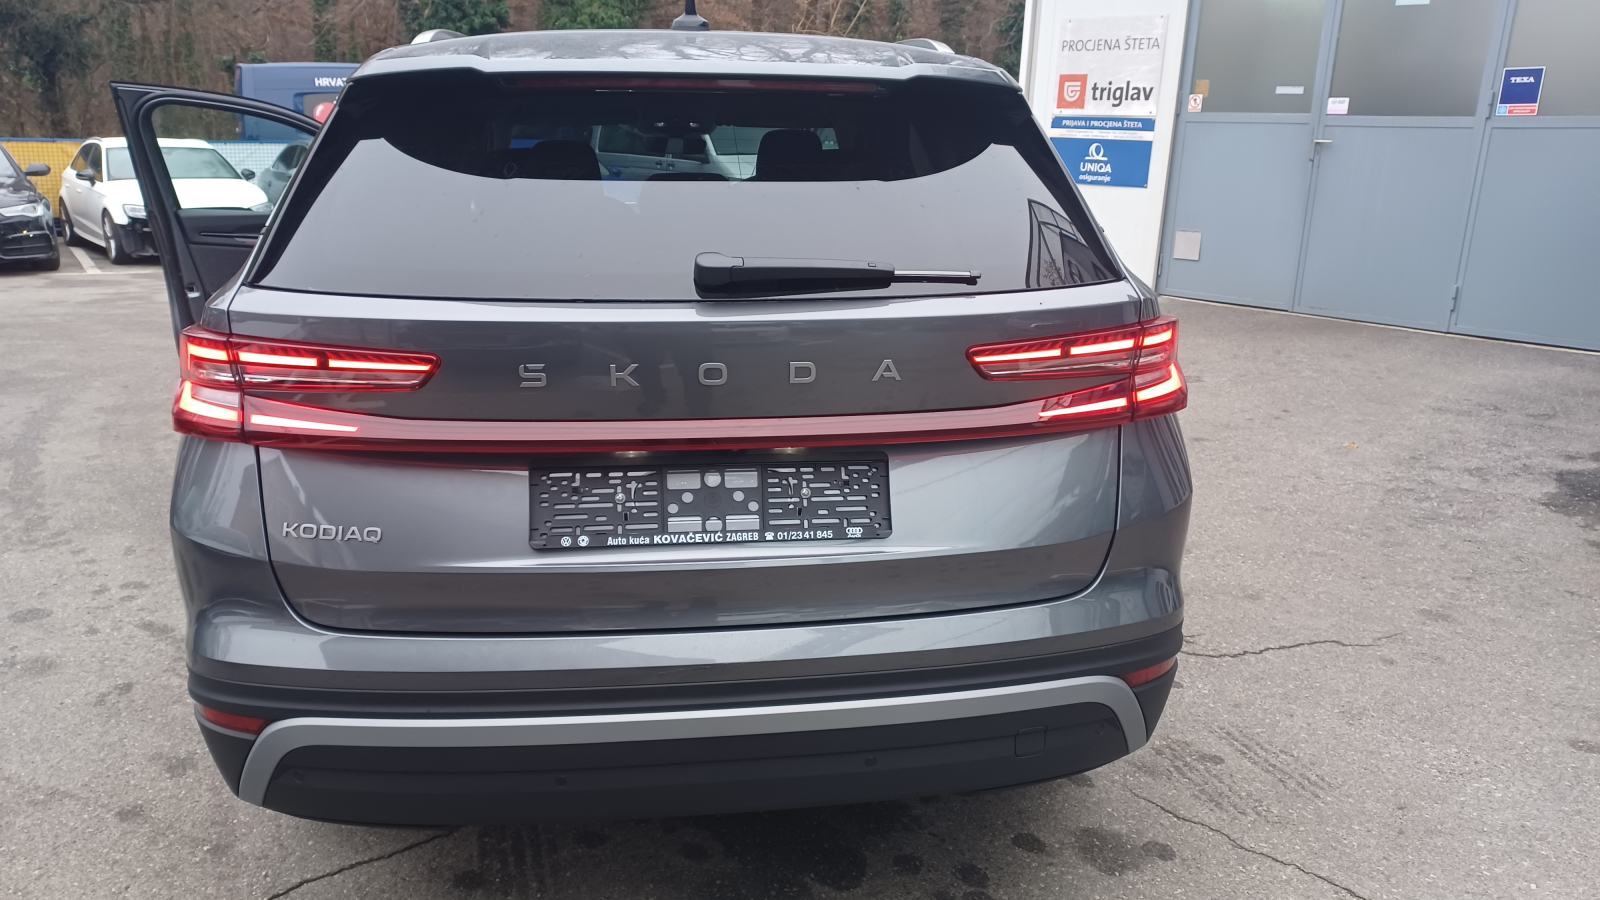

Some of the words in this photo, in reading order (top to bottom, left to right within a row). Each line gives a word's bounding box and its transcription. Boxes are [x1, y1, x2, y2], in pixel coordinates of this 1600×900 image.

[1061, 39, 1121, 52] PROCJENA
[1124, 35, 1160, 51] ŠTETA
[1510, 76, 1535, 84] TEXA
[1091, 80, 1154, 108] triglav
[1062, 119, 1086, 128] PRIJAVA
[1090, 120, 1122, 129] PROCJENA
[1123, 120, 1143, 129] ŠTETA
[1080, 161, 1112, 173] UNIQA
[1079, 173, 1111, 183] osiguranje
[281, 521, 382, 544] KODIAQ
[607, 536, 627, 546] Auto
[629, 535, 650, 545] kuća
[726, 532, 759, 541] ZAGREB
[816, 530, 834, 539] 845
